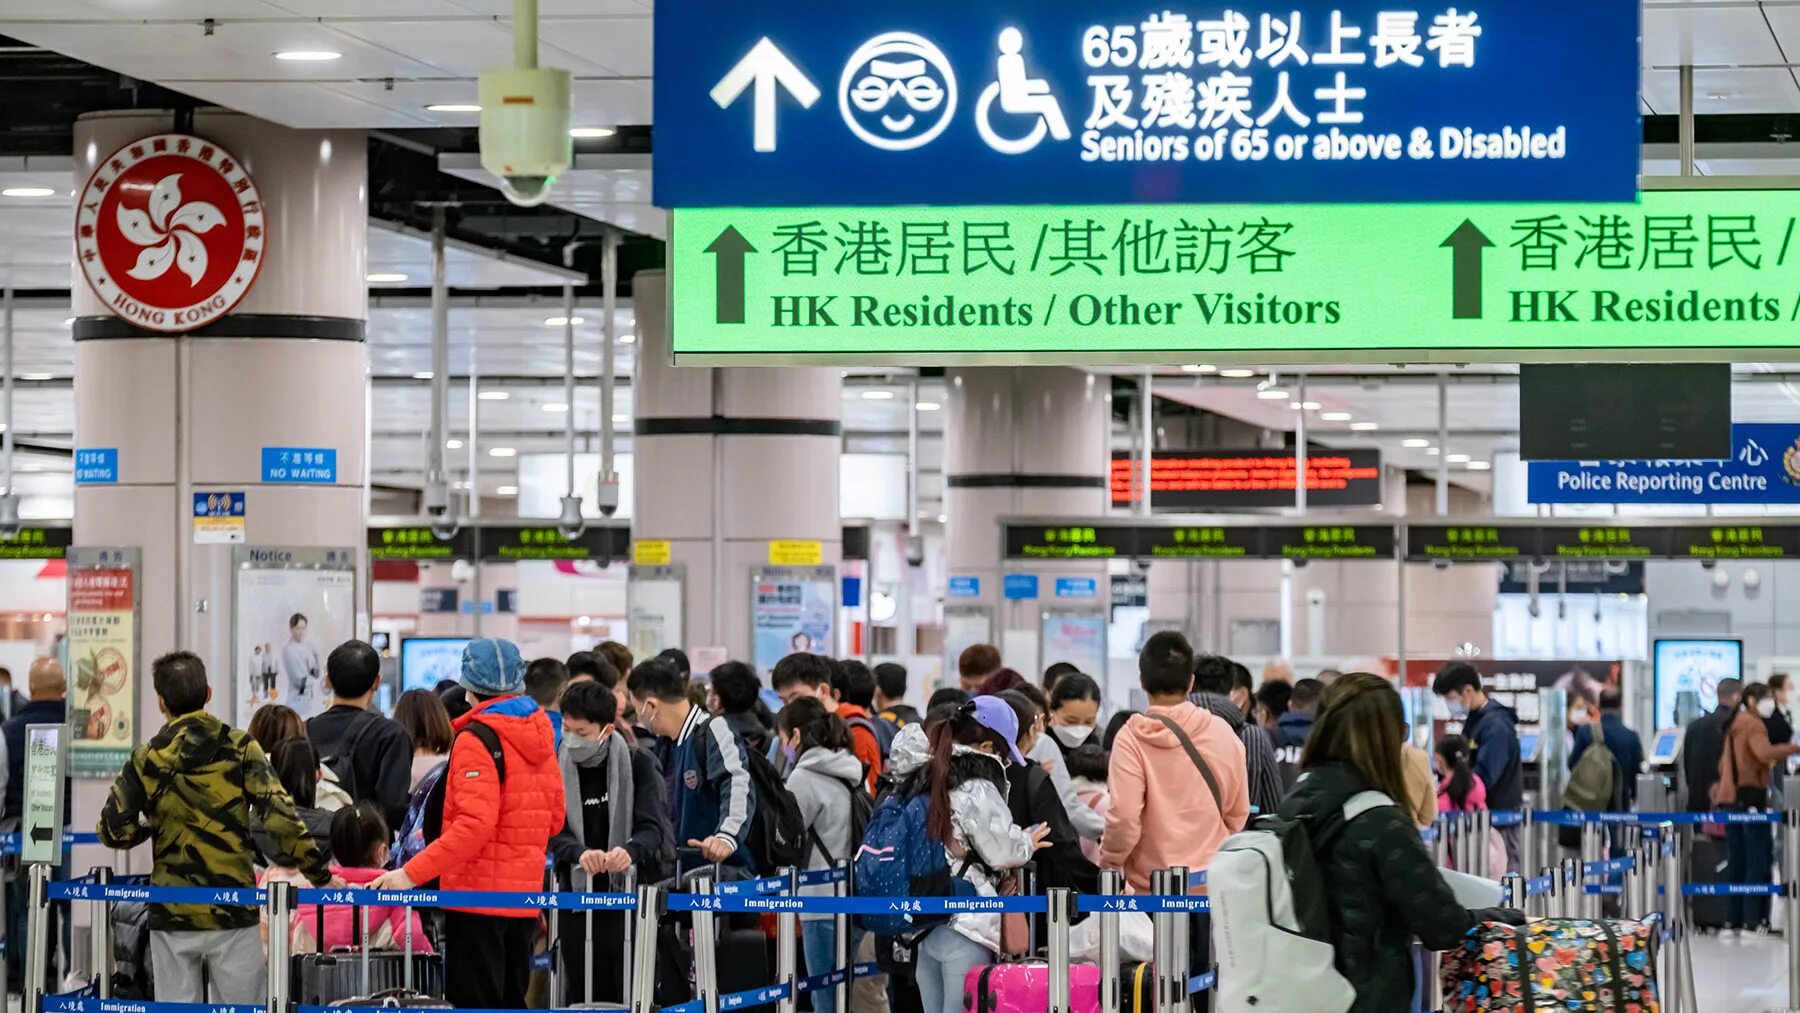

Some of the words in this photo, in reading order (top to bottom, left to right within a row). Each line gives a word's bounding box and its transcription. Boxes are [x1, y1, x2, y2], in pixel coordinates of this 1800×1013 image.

[1082, 8, 1482, 69] 65歲或以上長者
[1086, 71, 1367, 130] 及殘疾人士
[1081, 130, 1190, 162] Seniors
[1195, 128, 1227, 161] of
[1231, 130, 1268, 160] 65
[1274, 136, 1309, 160] or
[1312, 128, 1402, 160] above
[1408, 129, 1434, 159] &
[1440, 125, 1566, 159] Disabled
[113, 293, 165, 325] HONG
[173, 294, 226, 326] KONG
[771, 296, 839, 327] HK
[851, 293, 1034, 327] Residents
[1043, 293, 1057, 328] /
[1069, 292, 1182, 327] Other
[1193, 291, 1341, 326] Visitors
[1508, 290, 1580, 323] HK
[1591, 289, 1780, 322] Residents
[270, 468, 287, 479] NO
[291, 468, 331, 479] WAITING
[1558, 470, 1612, 491] Police
[1616, 470, 1703, 495] Reporting
[1708, 471, 1767, 491] Centre
[249, 549, 293, 562] Notice
[64, 886, 88, 898] 入境處
[105, 887, 149, 900] Immigration
[214, 890, 239, 902] 入境處
[322, 892, 354, 903] 入境處
[378, 892, 437, 904] Immigration
[524, 895, 559, 906] 入境處
[581, 895, 635, 906] Immigratio
[690, 898, 722, 909] 入境處
[744, 898, 803, 909] Immigration
[889, 900, 922, 911] 入境處
[944, 899, 1004, 910] Immigration
[1103, 899, 1138, 910] 入境處
[1162, 898, 1212, 910] Immigrat
[101, 1002, 146, 1013] Immigration
